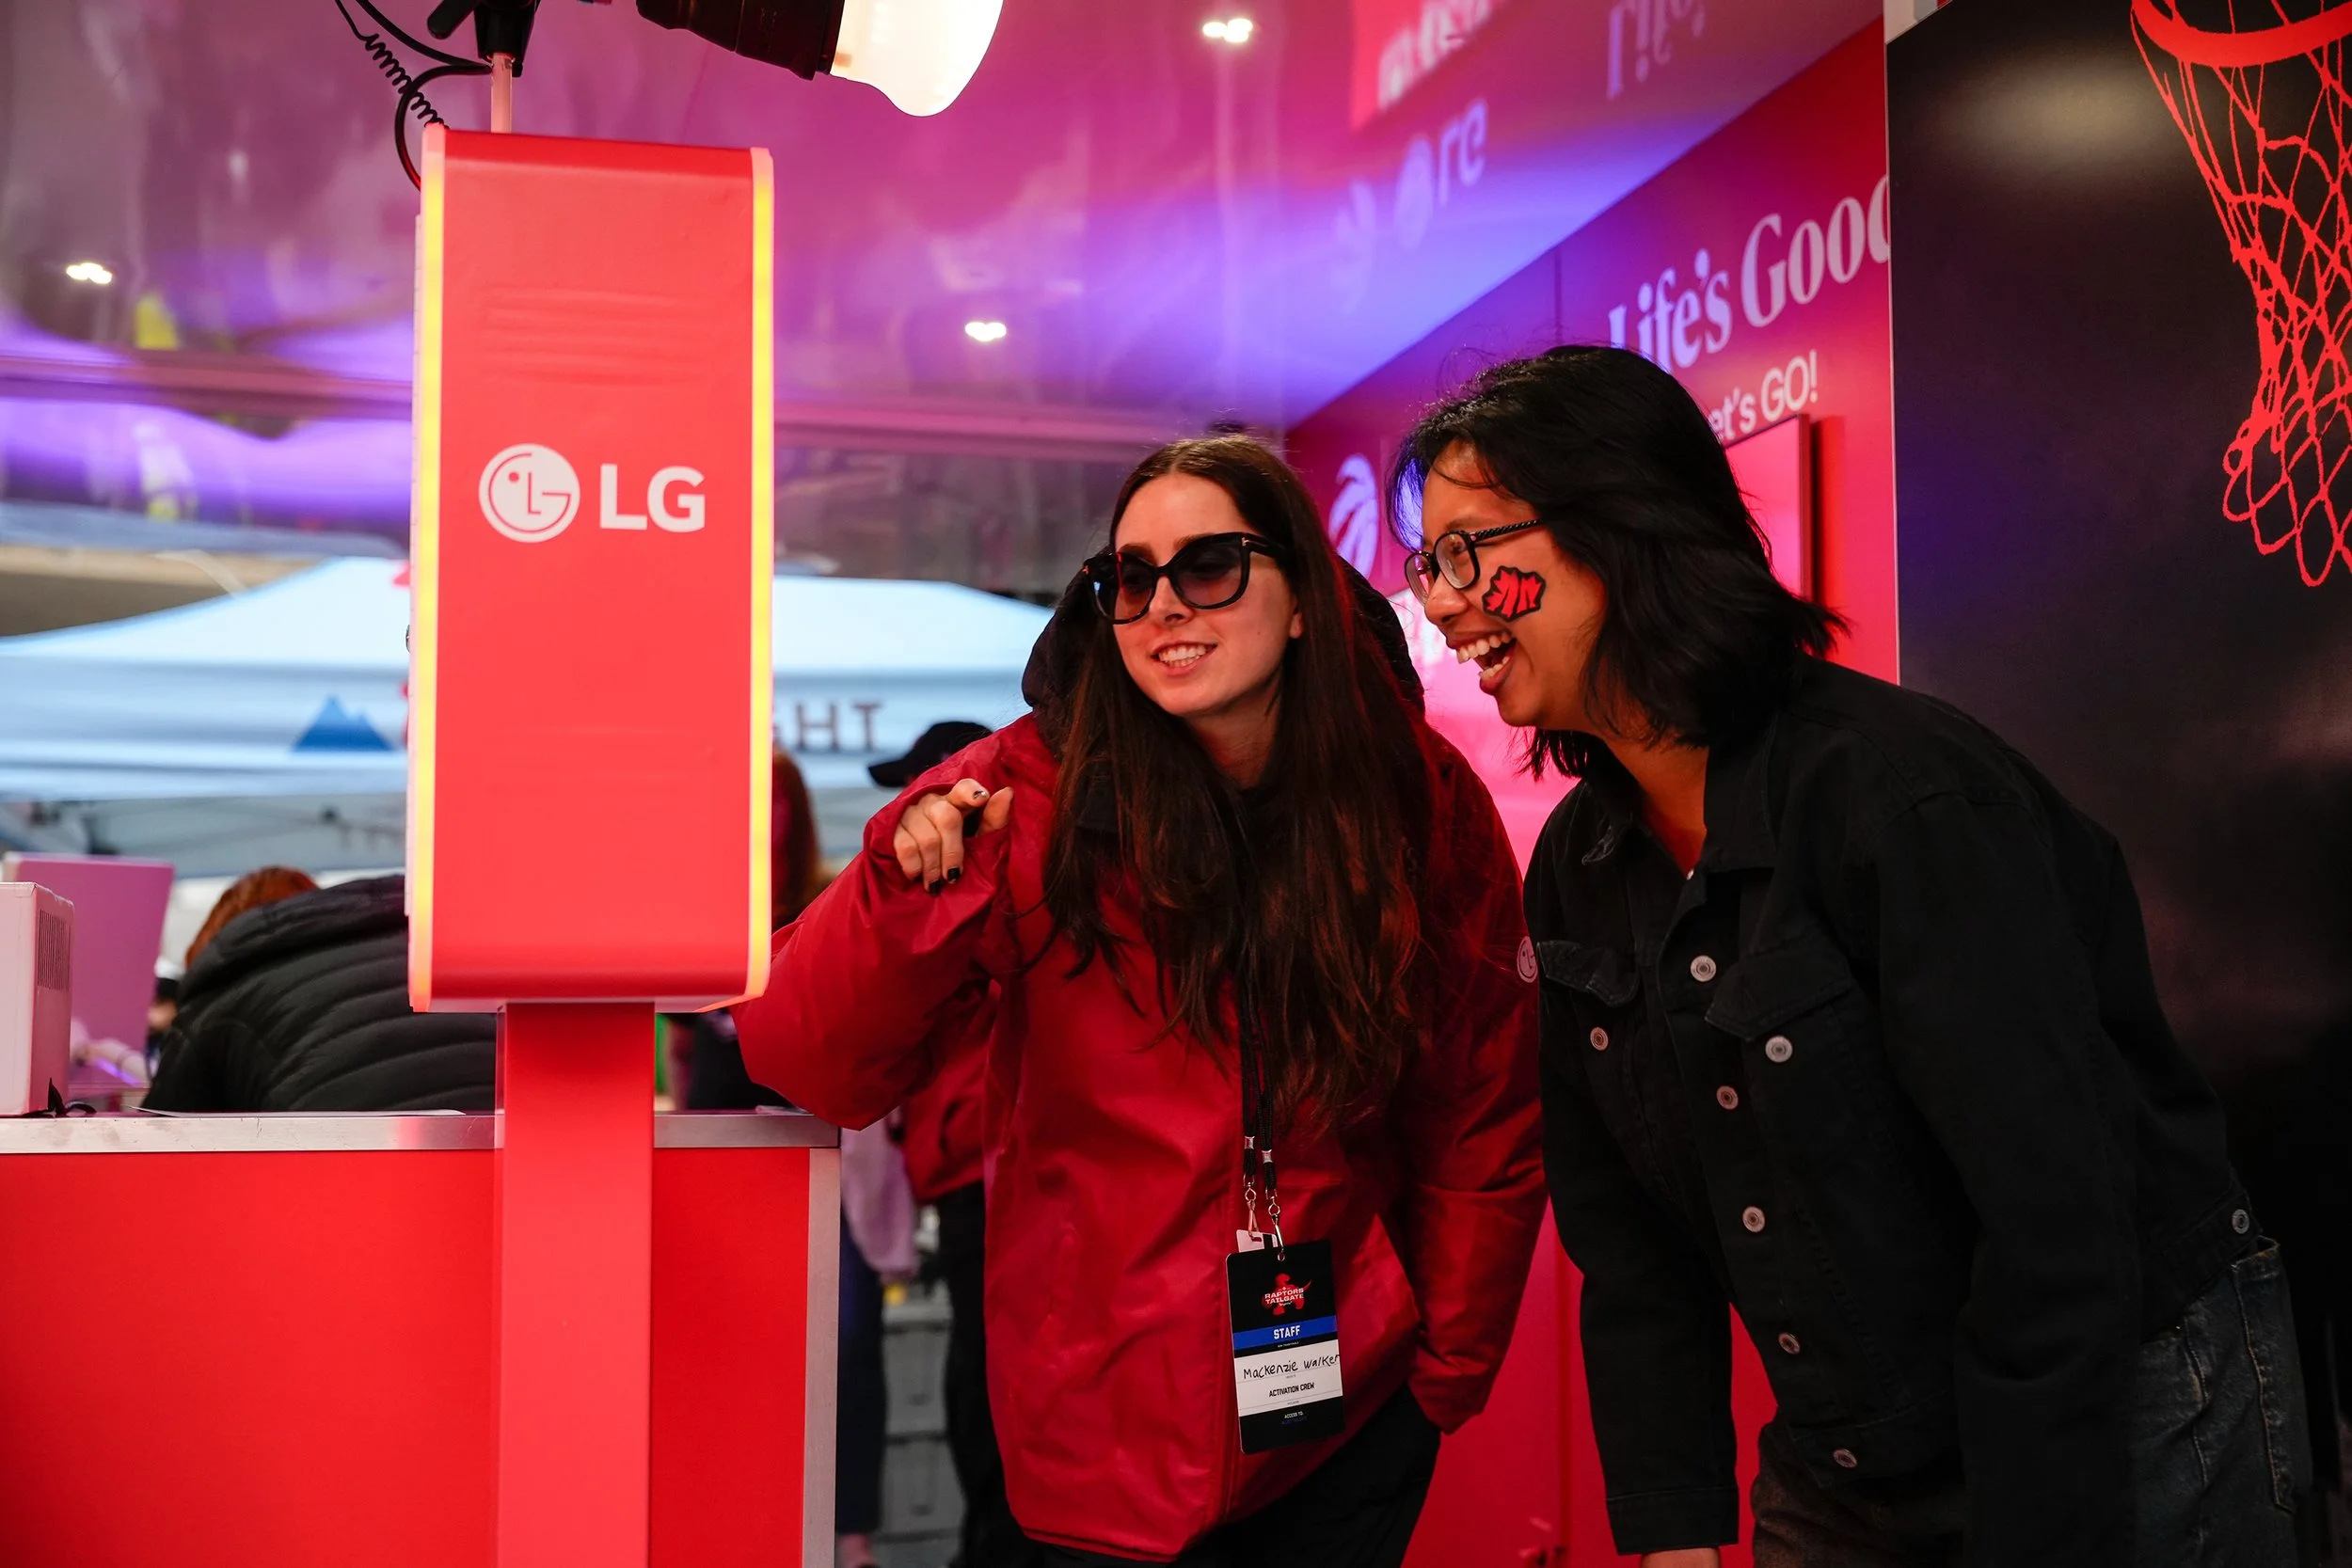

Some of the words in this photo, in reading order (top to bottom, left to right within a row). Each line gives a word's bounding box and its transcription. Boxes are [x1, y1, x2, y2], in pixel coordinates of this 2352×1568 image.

[1708, 387, 1756, 440] et's
[1760, 349, 1818, 422] GO!
[599, 464, 706, 532] LG
[1264, 1288, 1304, 1299] RAPTORS
[1265, 1293, 1304, 1305] TAILGATE
[1273, 1325, 1300, 1339] STAFF
[1269, 1386, 1299, 1397] ACTIVATION
[1300, 1382, 1314, 1391] CREW
